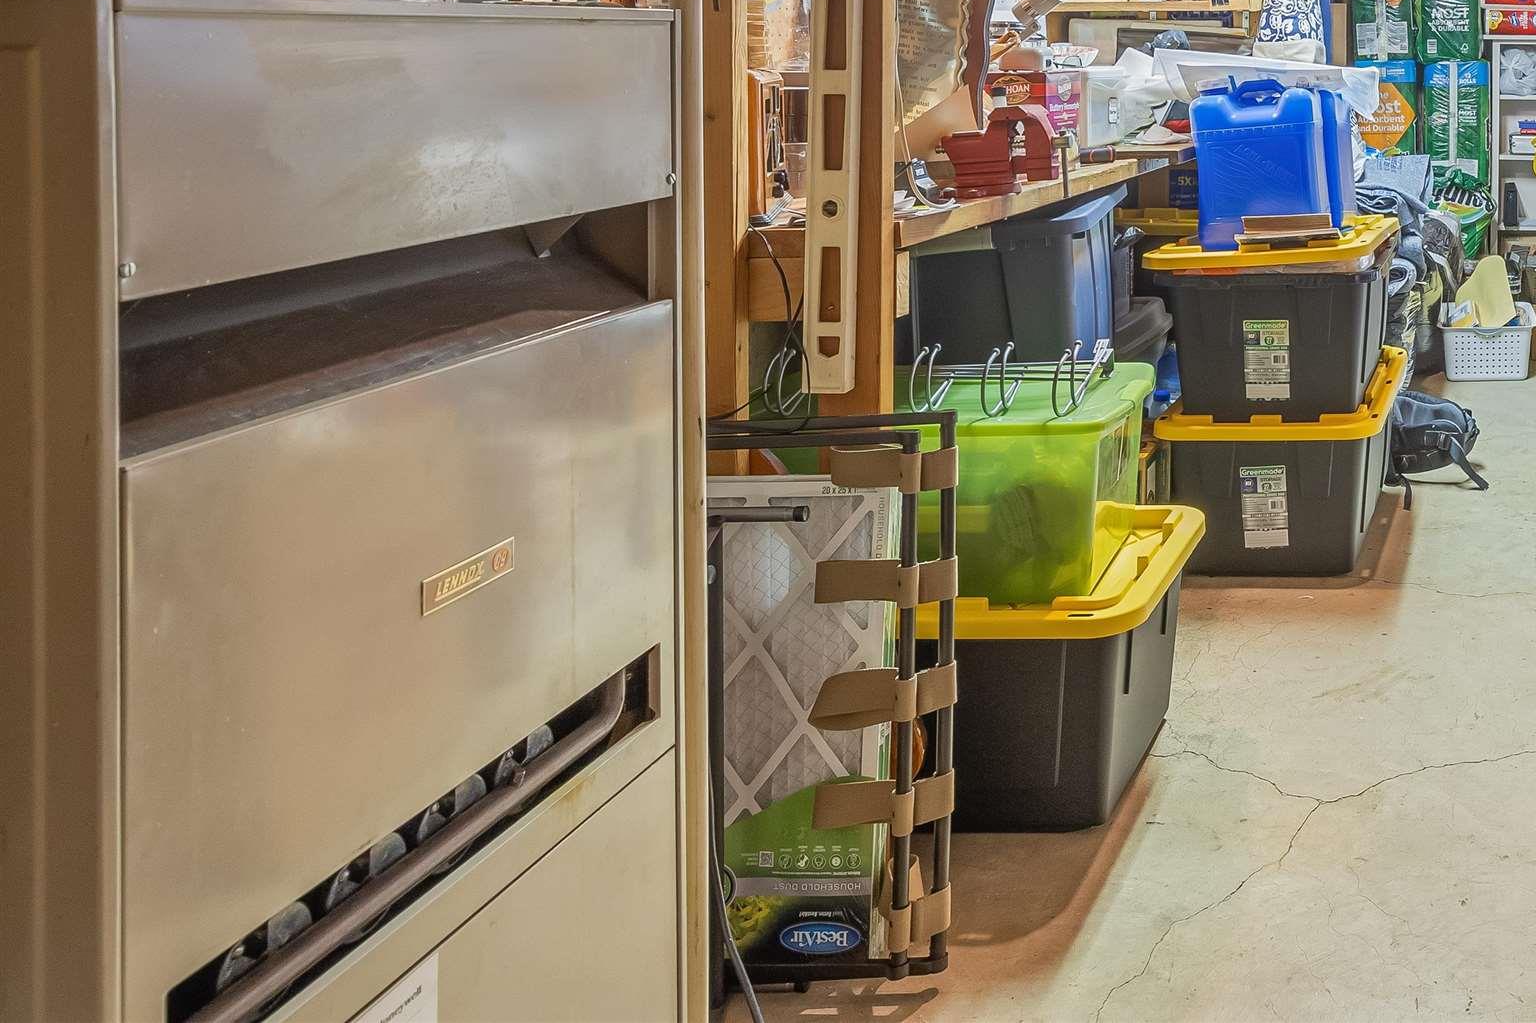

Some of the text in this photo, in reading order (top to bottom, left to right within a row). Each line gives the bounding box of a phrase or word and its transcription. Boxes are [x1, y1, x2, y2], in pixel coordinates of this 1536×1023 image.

[1431, 7, 1470, 19] MOST
[1377, 101, 1401, 114] ost
[1373, 124, 1405, 132] Durable
[1241, 468, 1284, 476] Greenmade
[838, 486, 847, 494] 25
[436, 560, 485, 598] LENNOX
[774, 882, 862, 891] HOUSEHOLD DUST
[791, 929, 849, 947] BestAir
